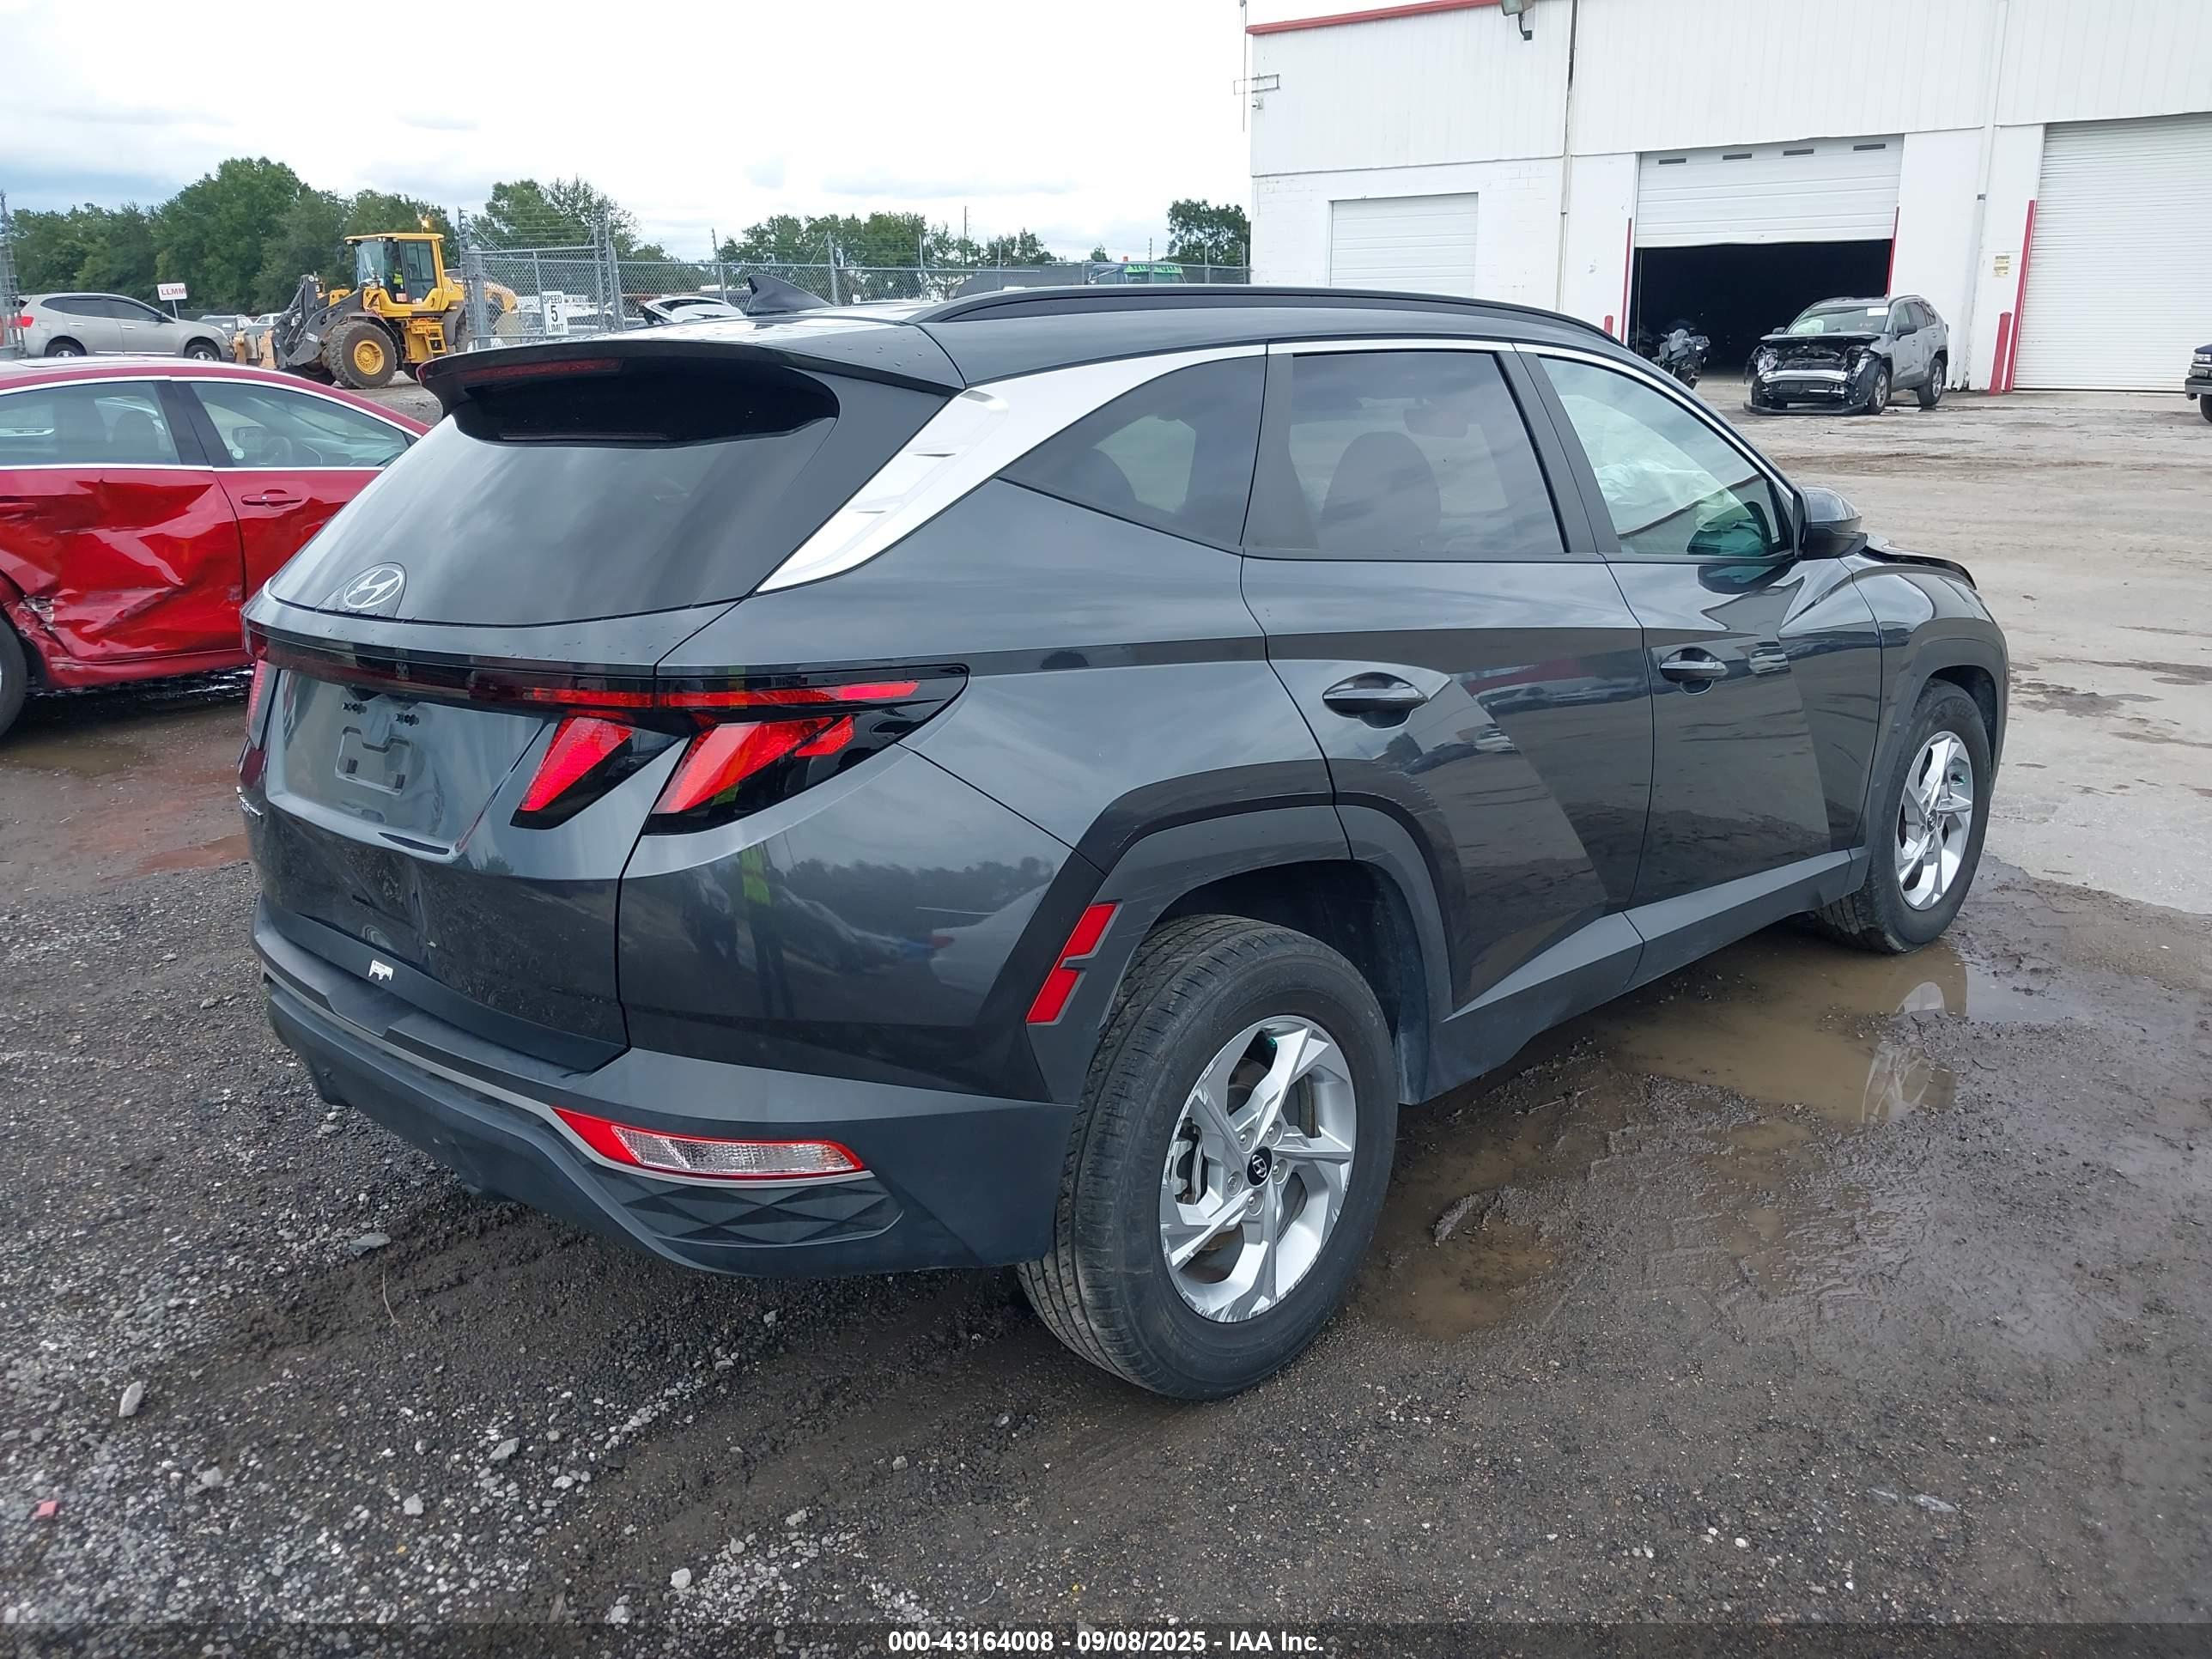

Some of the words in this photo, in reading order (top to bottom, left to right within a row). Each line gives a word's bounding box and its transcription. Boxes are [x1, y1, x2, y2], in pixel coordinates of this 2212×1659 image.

[543, 295, 562, 304] SPEED
[550, 305, 558, 322] 5
[547, 323, 563, 333] LIMIT
